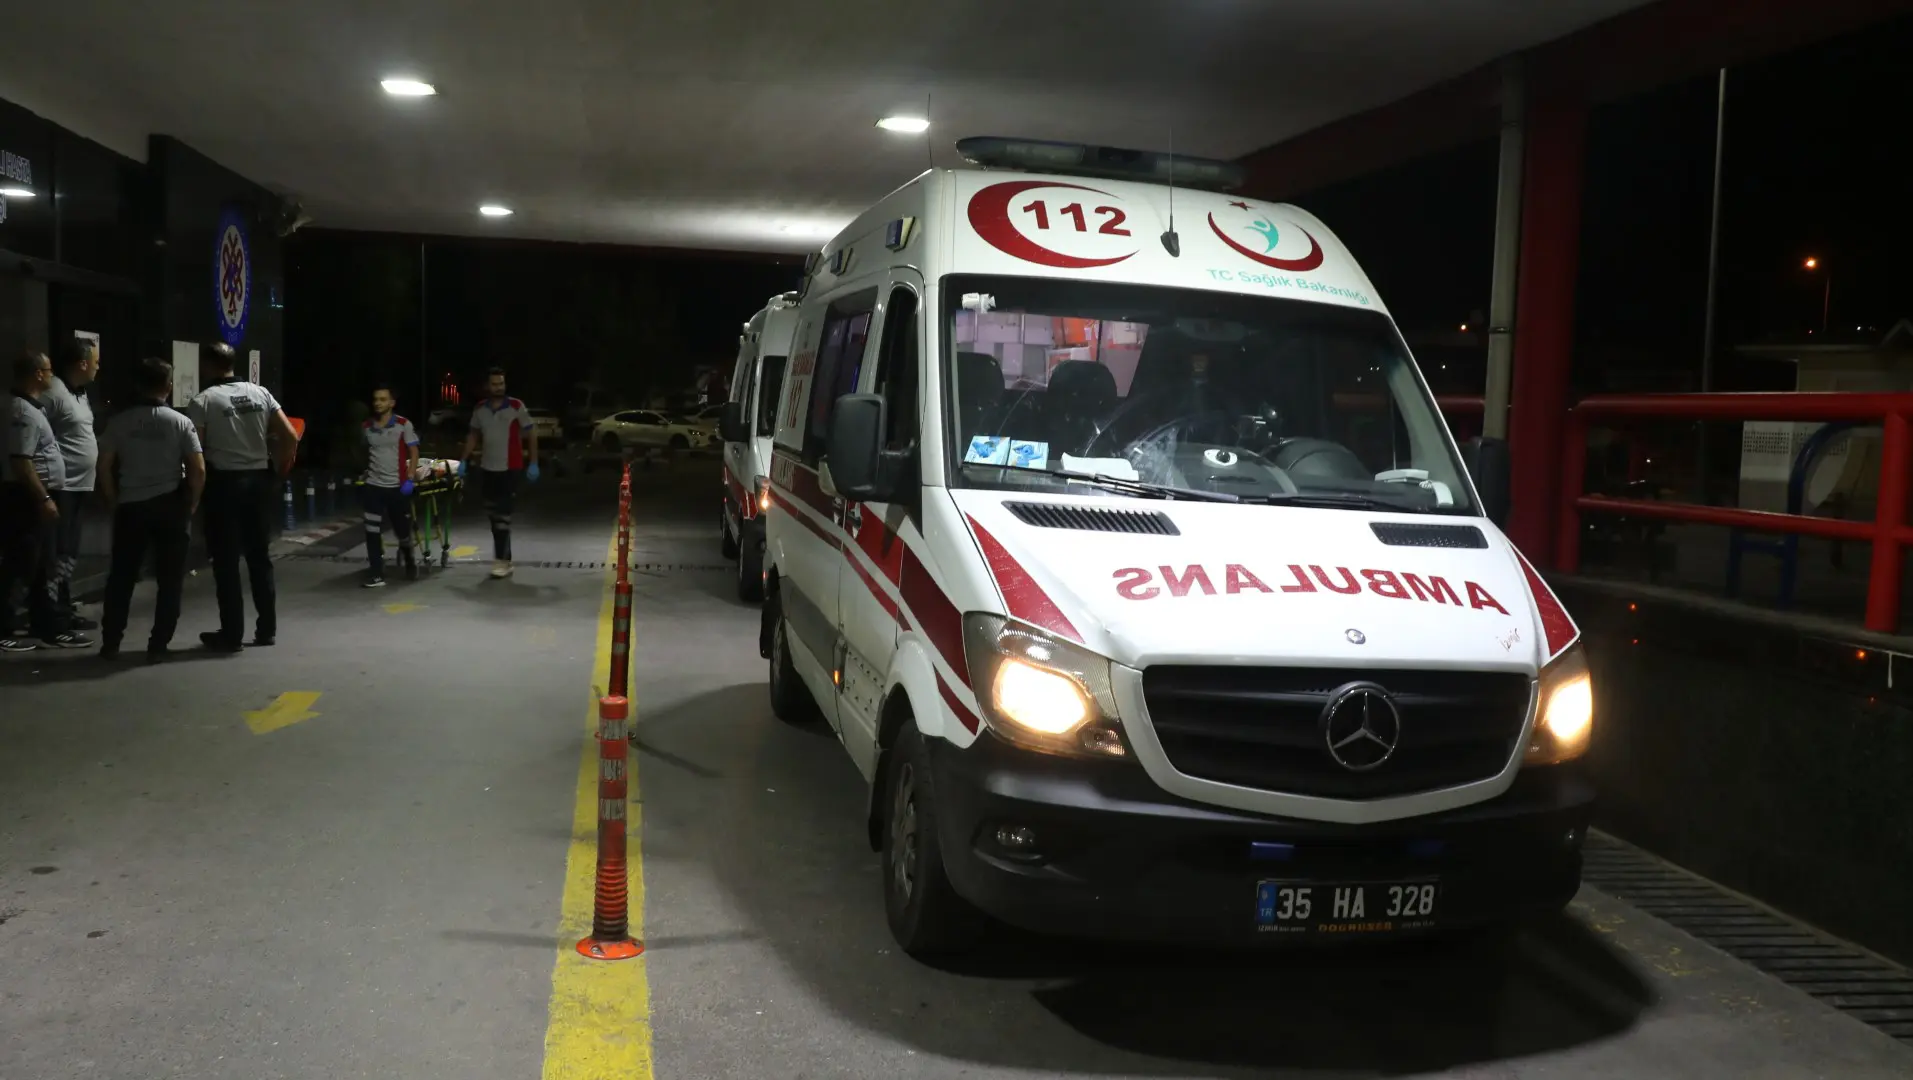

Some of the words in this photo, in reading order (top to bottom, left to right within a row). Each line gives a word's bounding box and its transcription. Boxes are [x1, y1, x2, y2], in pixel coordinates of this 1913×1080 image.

[1023, 199, 1132, 238] 112
[1207, 268, 1234, 281] TC
[1238, 270, 1293, 288] Sağlık
[1295, 277, 1370, 305] Bakanlığı
[1260, 907, 1273, 917] TR
[1276, 888, 1312, 920] 35
[1333, 886, 1365, 918] HA
[1386, 884, 1435, 917] 328
